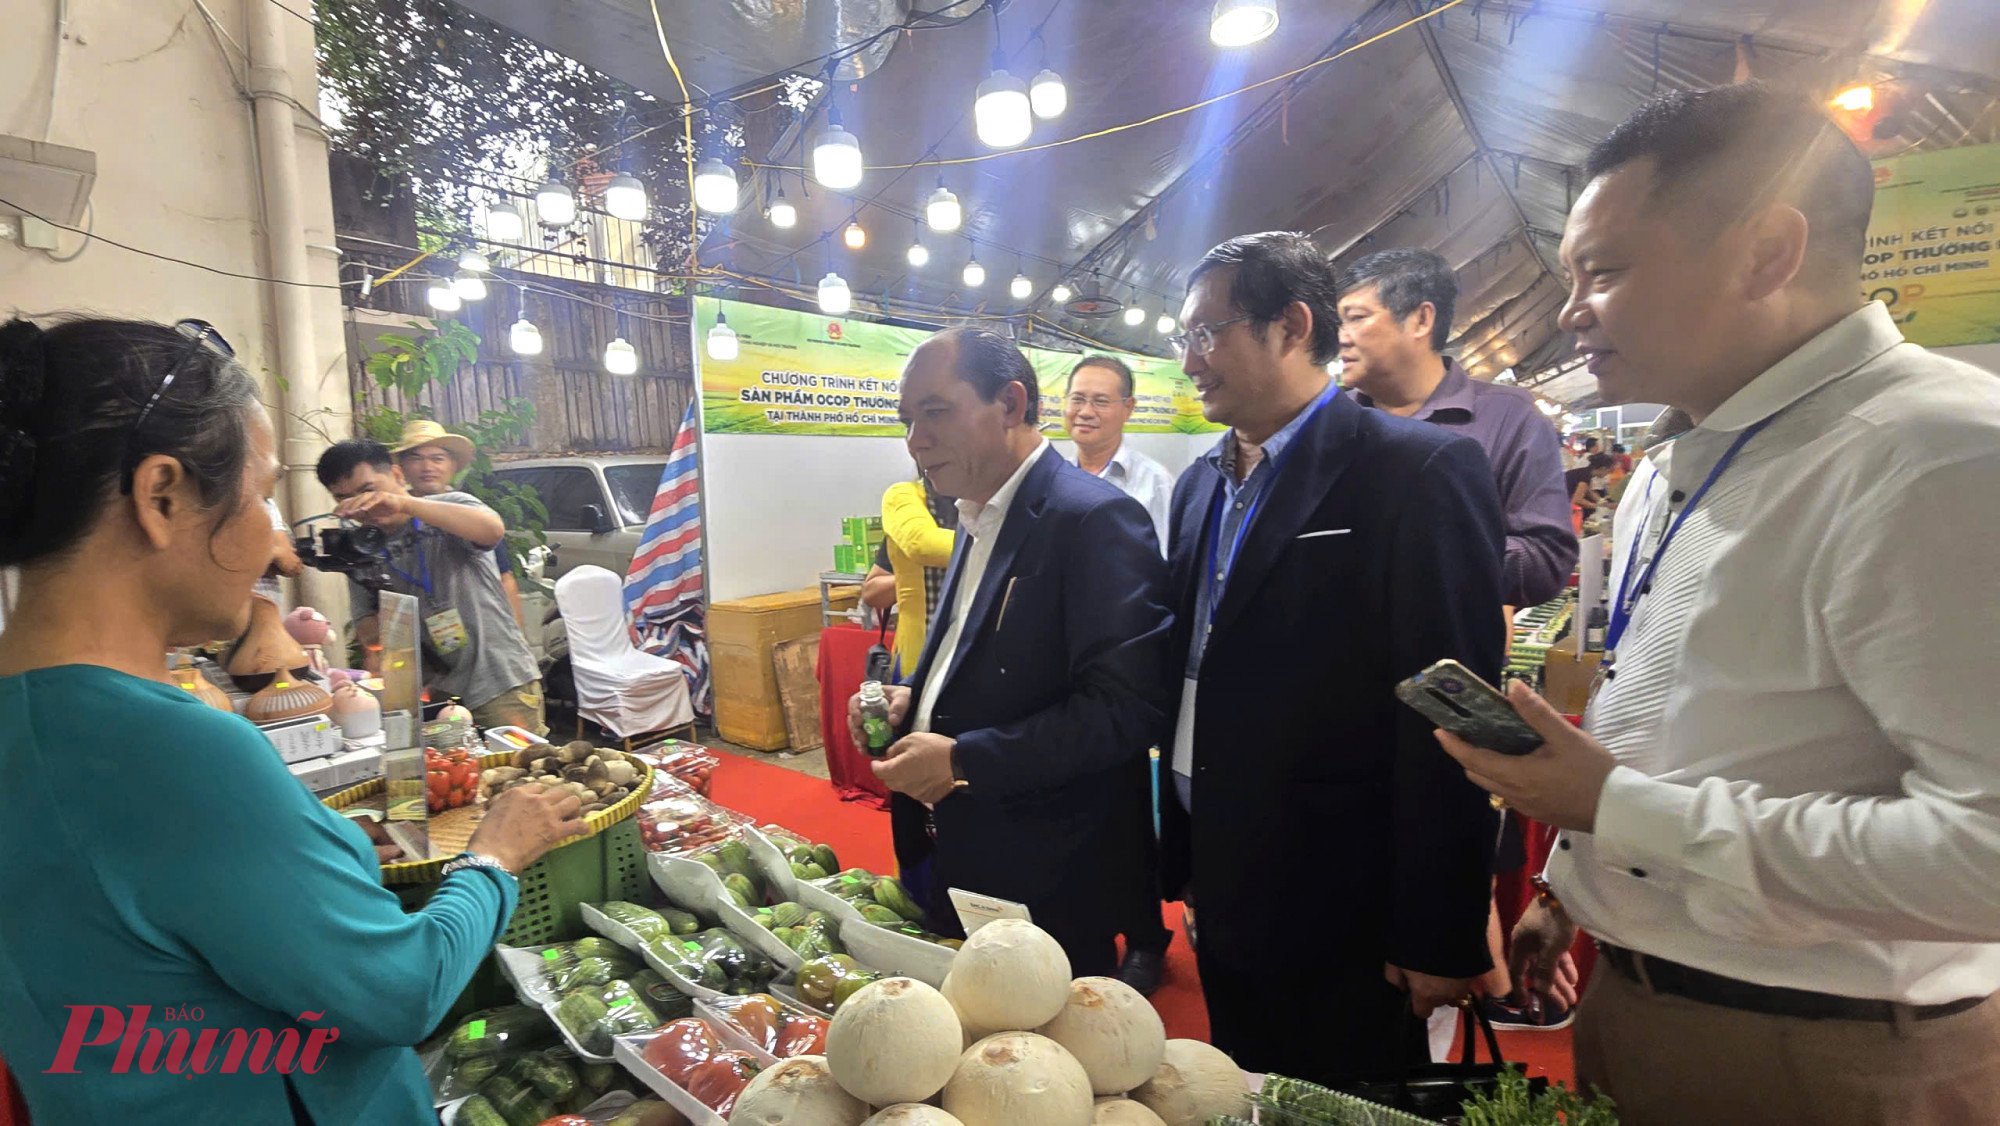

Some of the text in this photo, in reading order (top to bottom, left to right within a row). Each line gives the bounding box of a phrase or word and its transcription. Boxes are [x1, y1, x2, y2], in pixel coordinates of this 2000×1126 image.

[1911, 225, 1950, 242] KẾT
[1864, 252, 1894, 265] OP
[1946, 259, 1989, 272] MINH
[762, 372, 817, 387] CHƯƠNG
[821, 376, 855, 390] TRÌNH
[858, 377, 879, 391] KẾT
[816, 394, 850, 407] OCOP
[767, 410, 783, 423] TẠI
[786, 411, 821, 422] THÀNH
